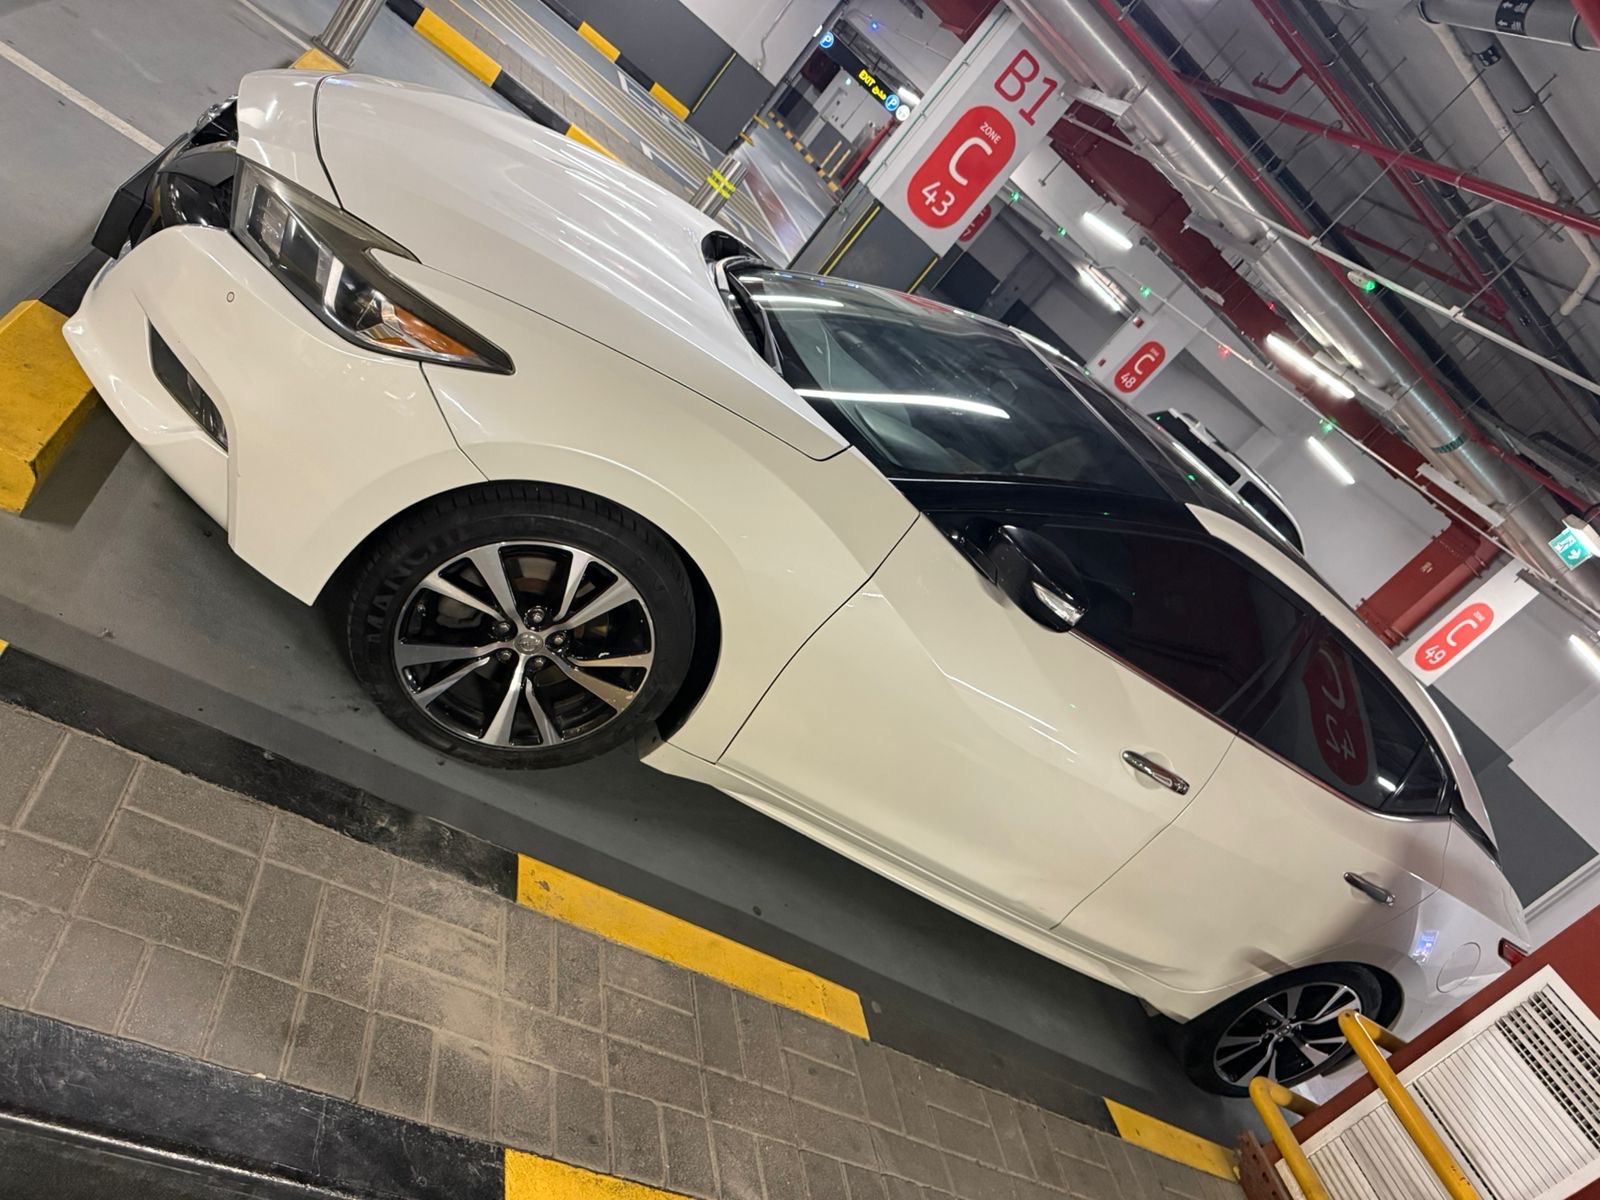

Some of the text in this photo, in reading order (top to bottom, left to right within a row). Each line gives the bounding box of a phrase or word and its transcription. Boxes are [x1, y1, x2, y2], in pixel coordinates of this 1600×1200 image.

[858, 69, 876, 86] EXIT
[994, 48, 1058, 126] B1
[979, 121, 1002, 145] ZONE
[948, 136, 993, 187] C
[921, 181, 956, 217] 43
[1134, 353, 1156, 375] C
[1120, 372, 1137, 389] 48
[1446, 618, 1479, 647] C
[1424, 644, 1447, 665] 49
